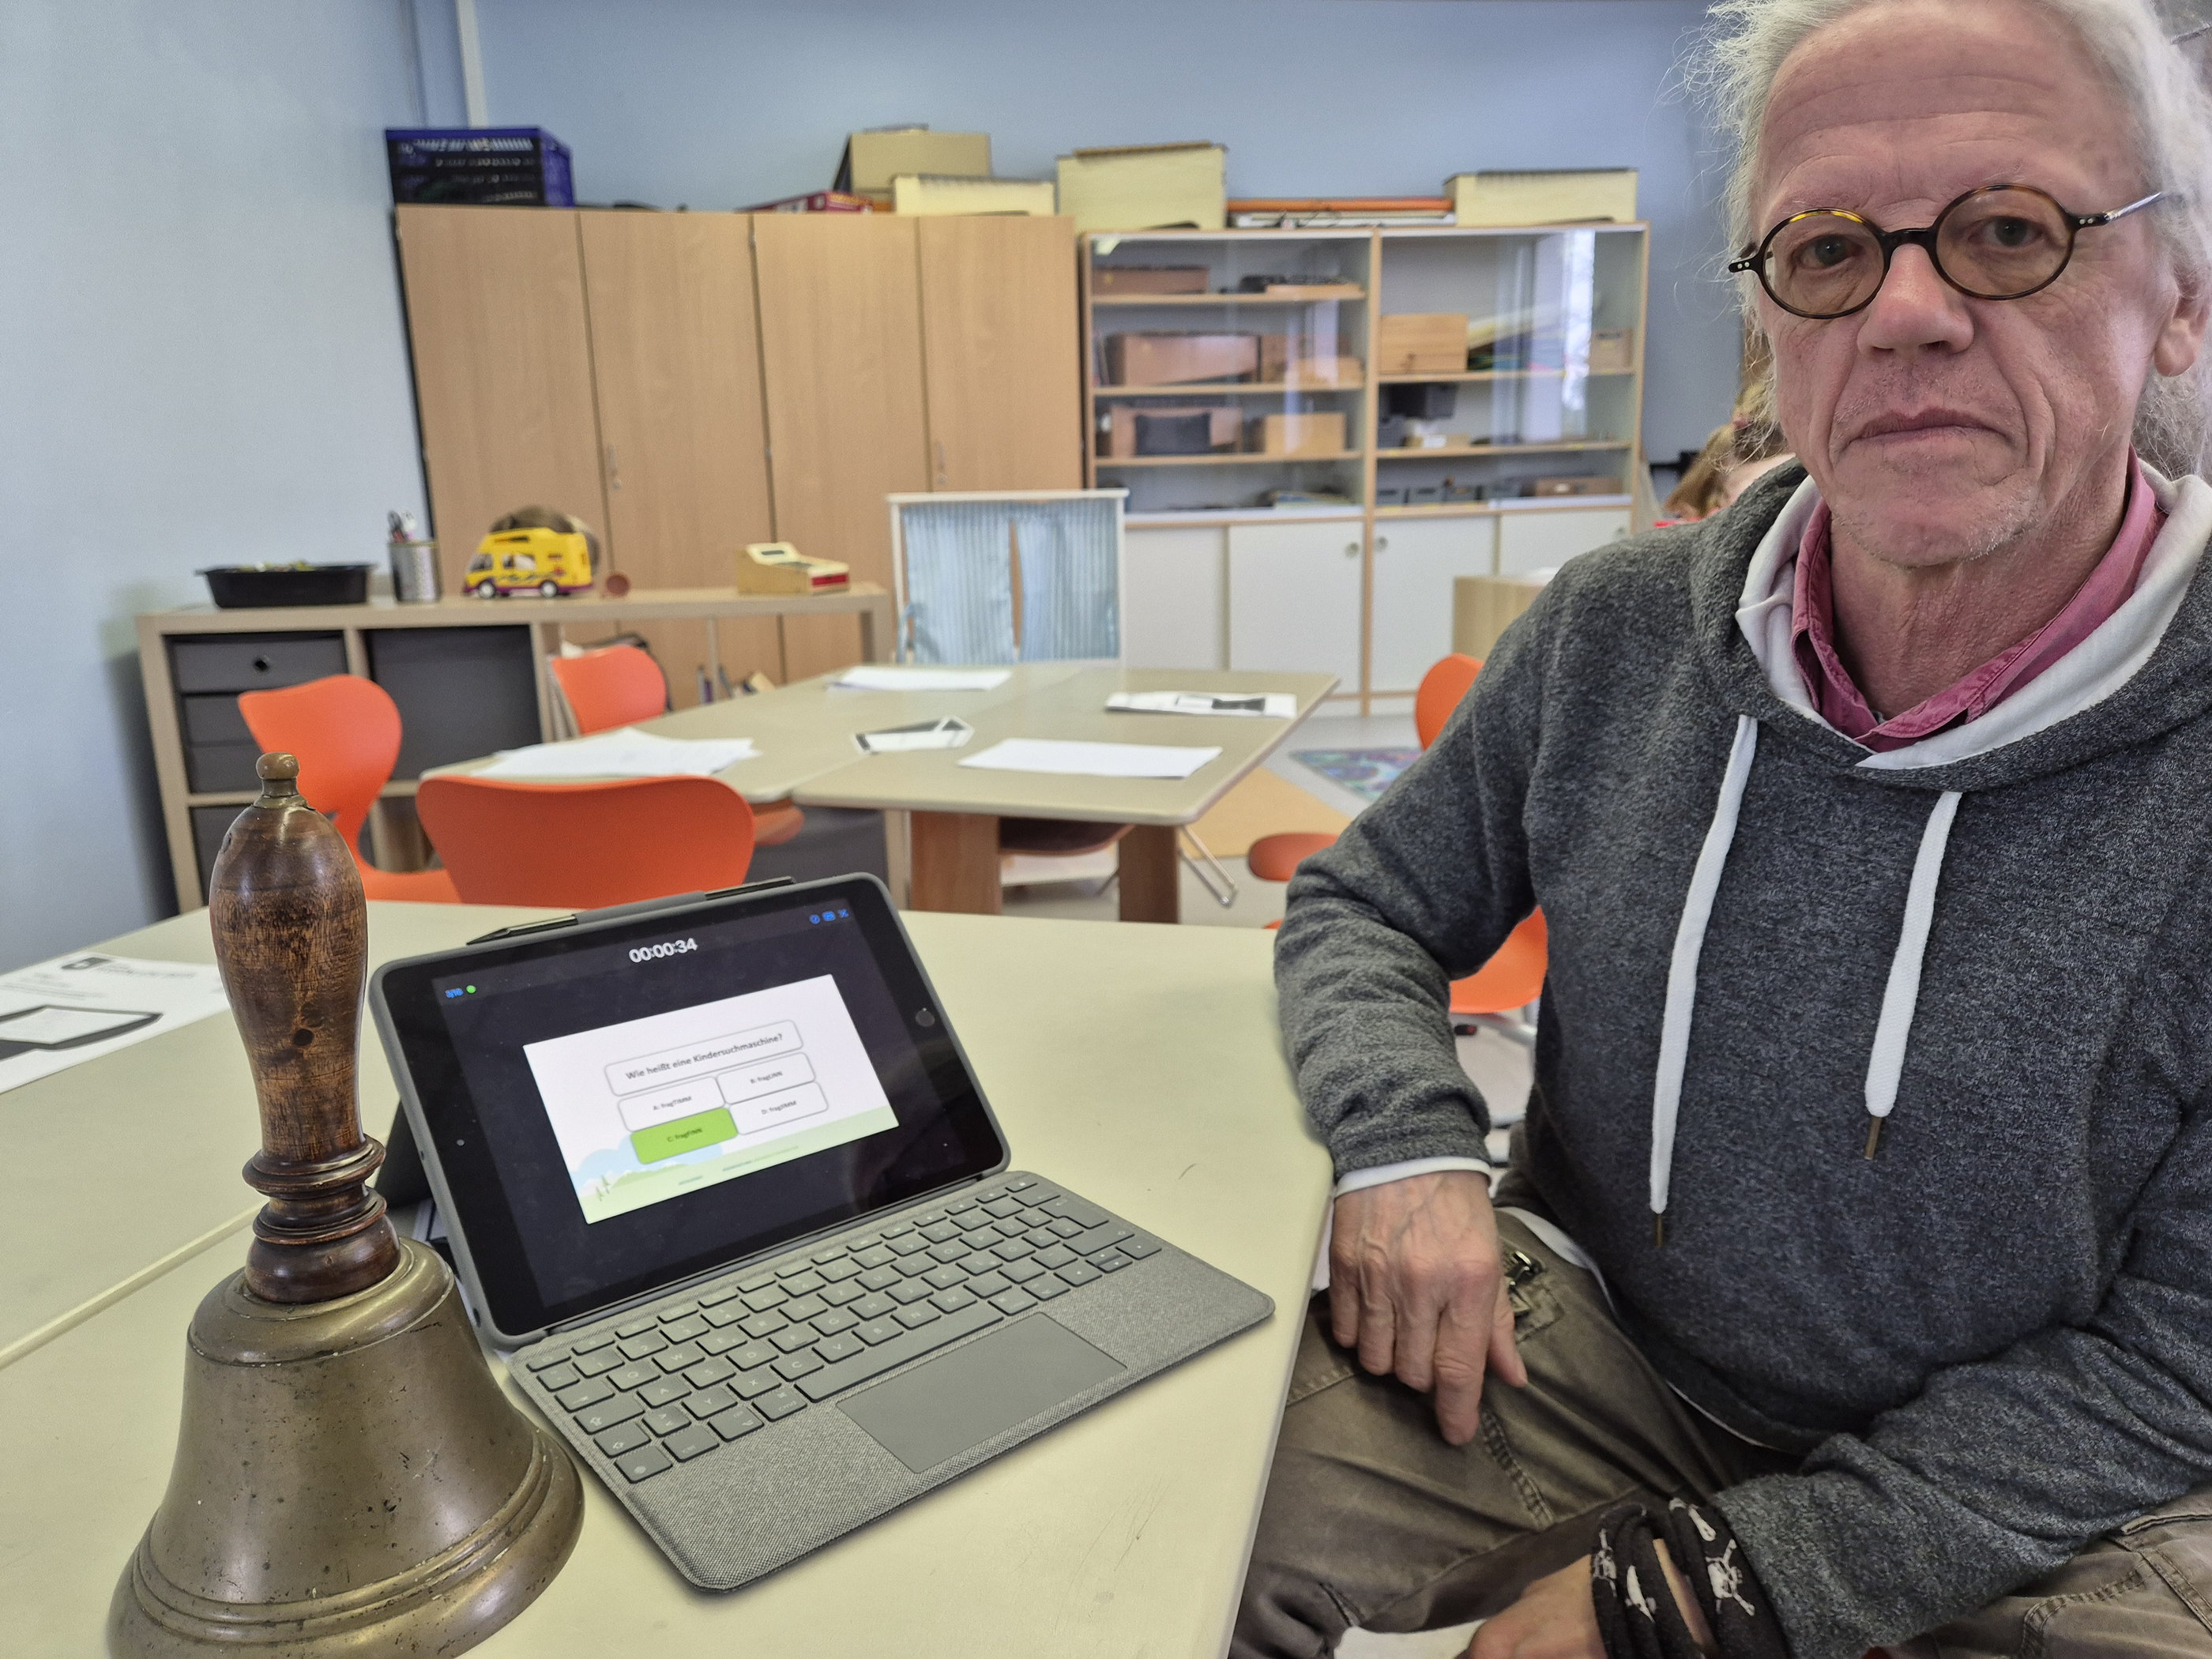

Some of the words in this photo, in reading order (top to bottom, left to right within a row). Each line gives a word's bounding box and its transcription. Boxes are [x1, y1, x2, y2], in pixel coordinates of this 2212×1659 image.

[629, 938, 698, 963] 00:00:34
[626, 1070, 645, 1080] Wie
[646, 1062, 671, 1074] heißt
[673, 1059, 692, 1069] eine
[694, 1033, 783, 1063] Kindersuchmaschine?
